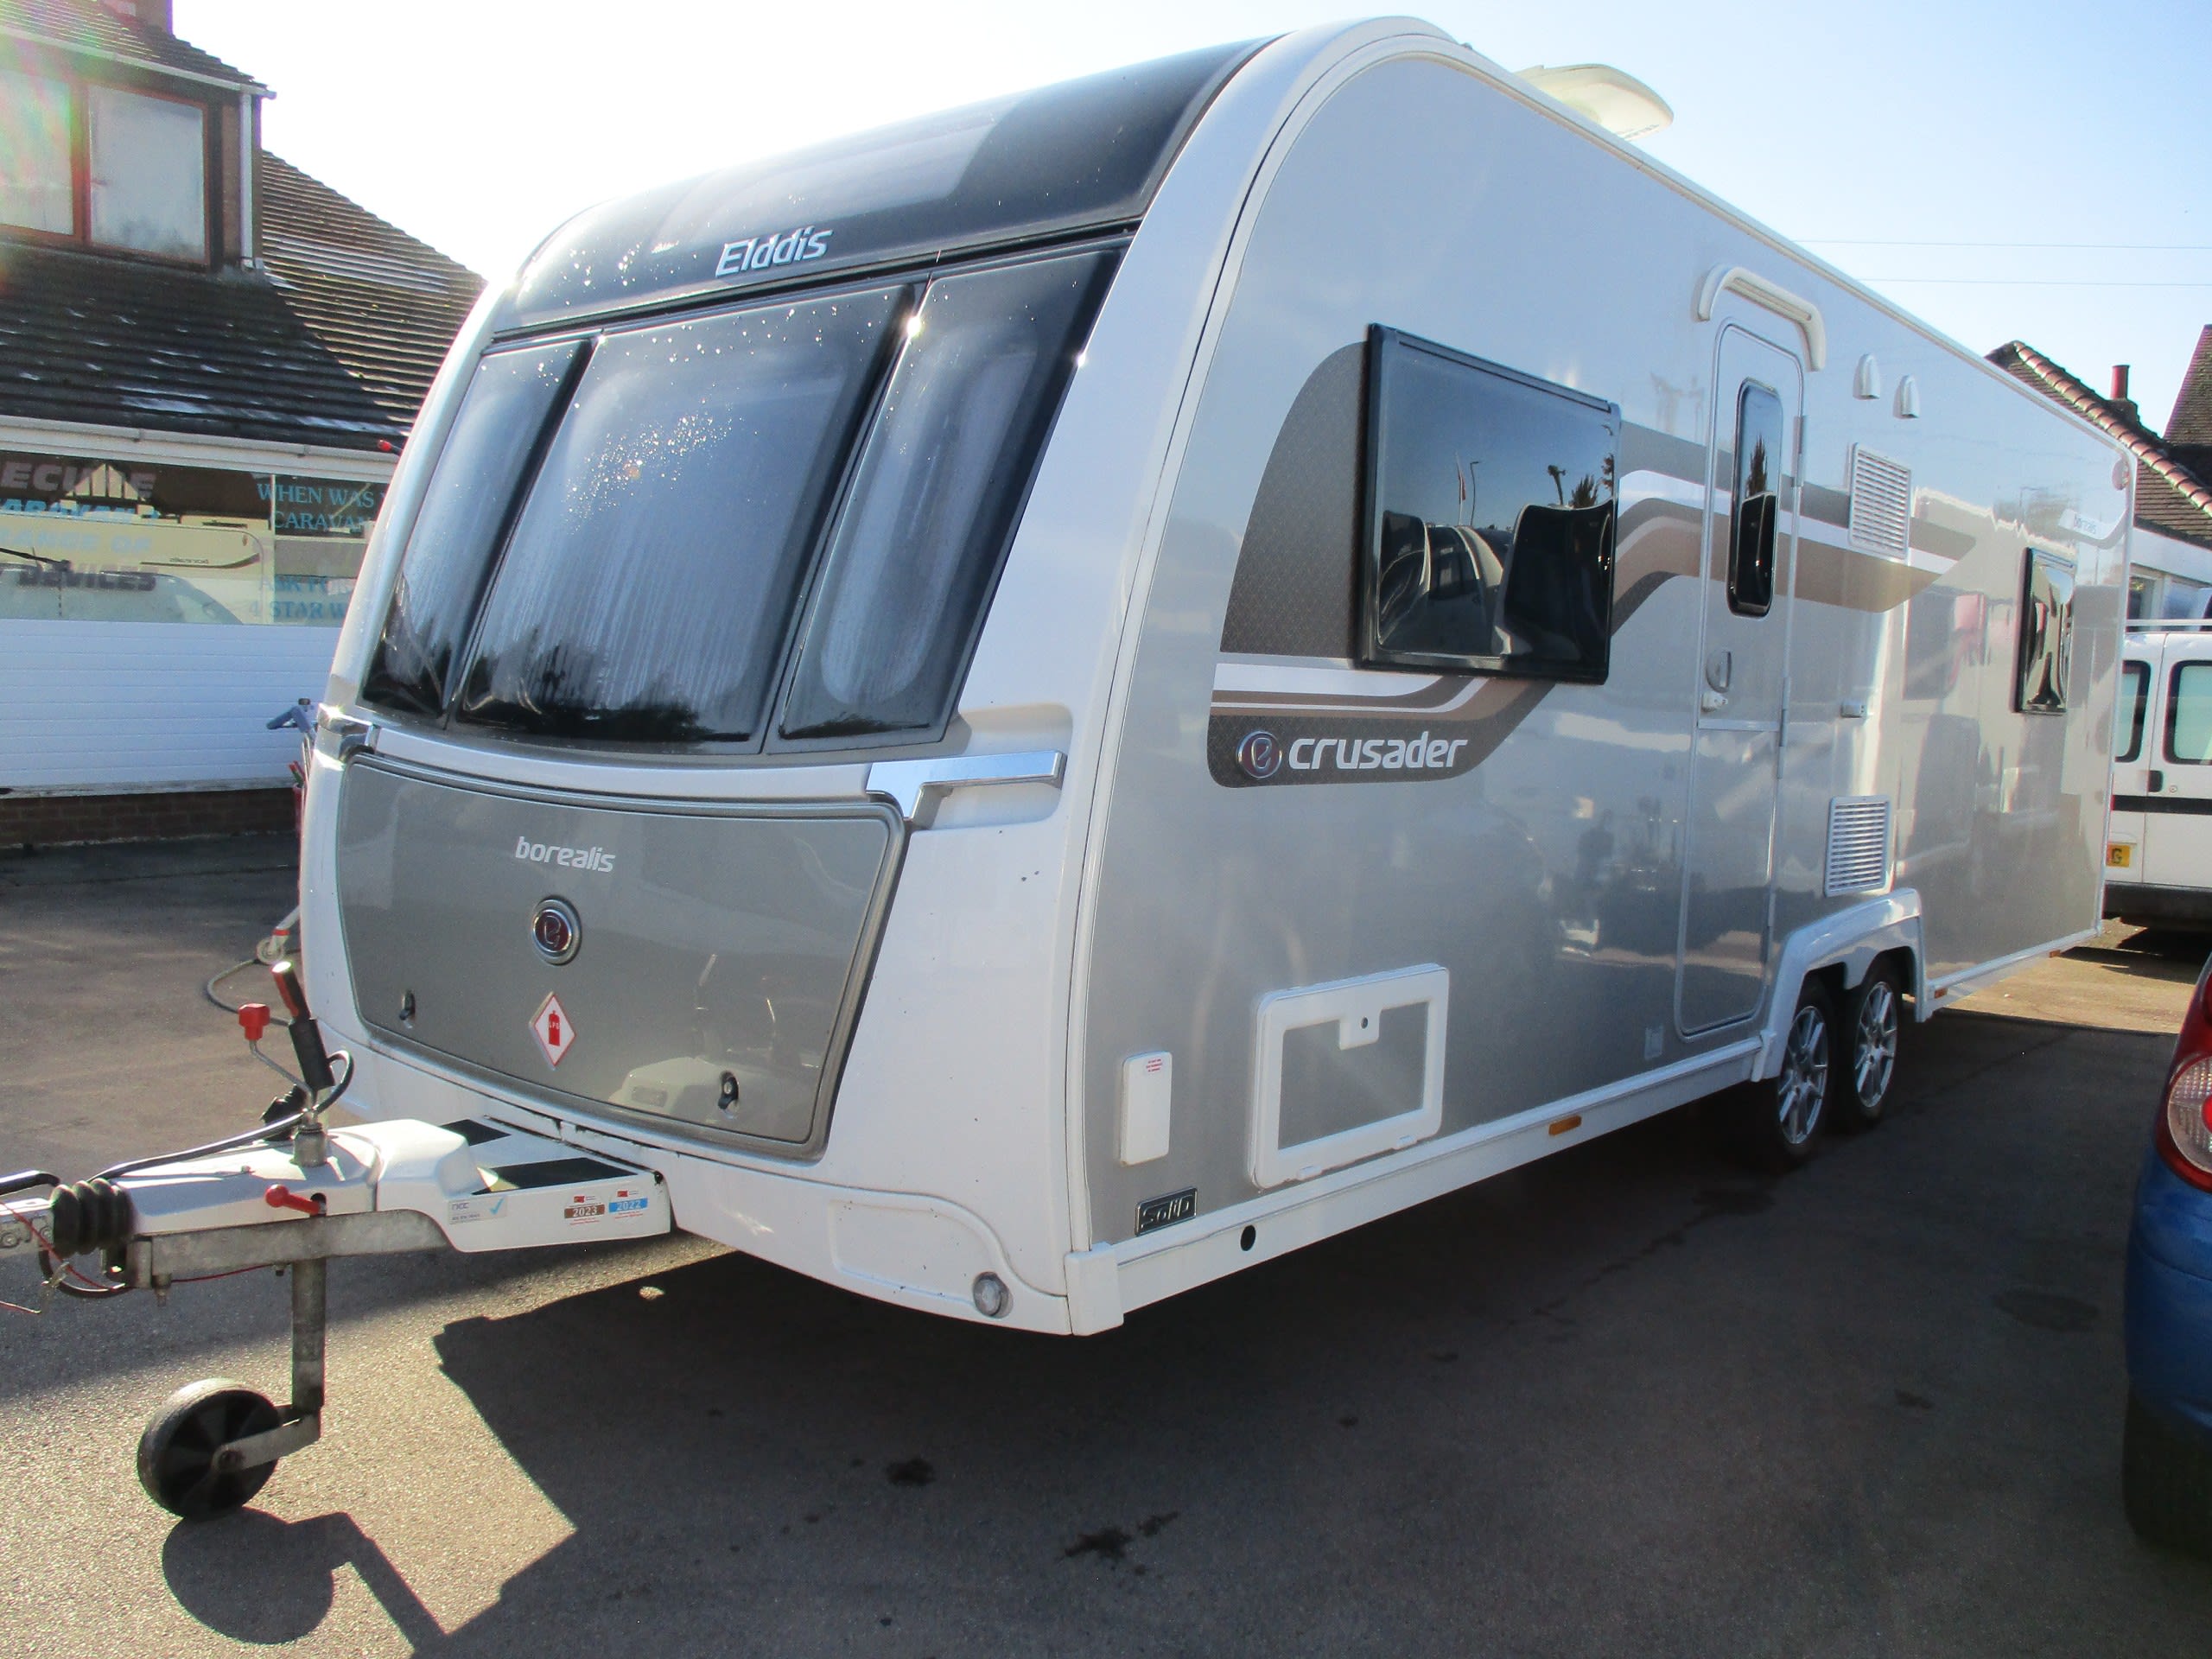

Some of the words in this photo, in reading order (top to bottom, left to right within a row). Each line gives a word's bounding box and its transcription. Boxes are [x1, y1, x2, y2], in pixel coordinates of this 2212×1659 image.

[715, 226, 833, 276] Elddis
[257, 484, 322, 504] WHEN
[328, 488, 374, 508] WAS
[1288, 731, 1467, 769] crusader
[515, 836, 615, 873] borealis
[573, 1206, 598, 1217] 2023
[617, 1200, 641, 1210] 2022
